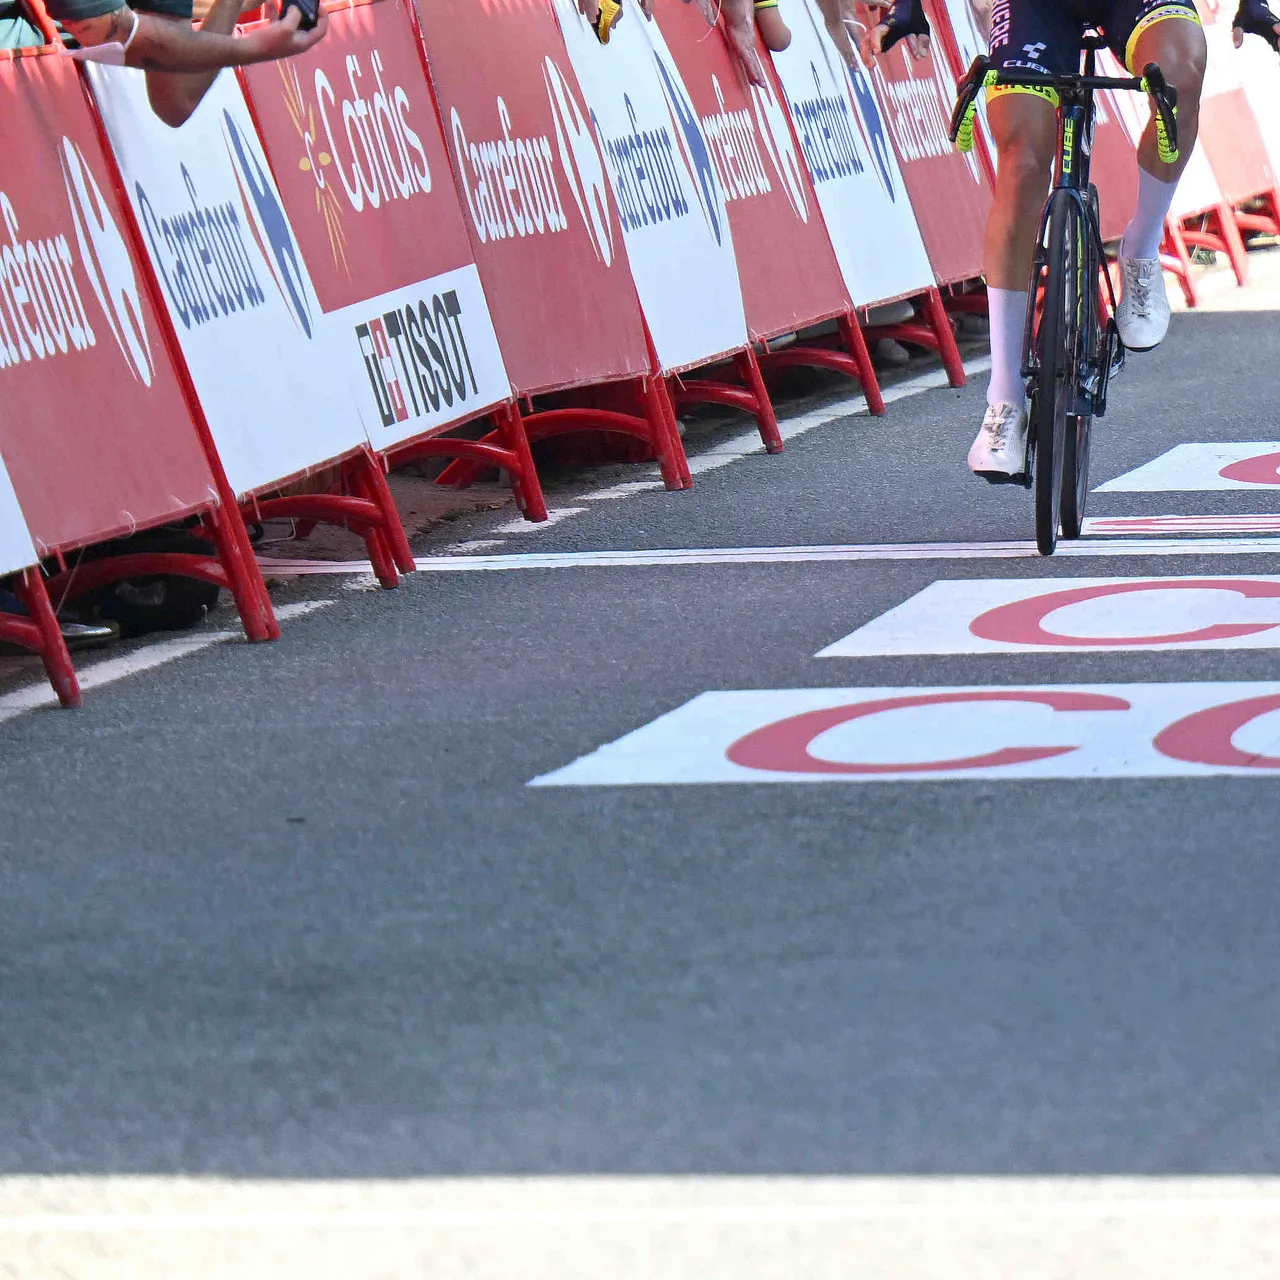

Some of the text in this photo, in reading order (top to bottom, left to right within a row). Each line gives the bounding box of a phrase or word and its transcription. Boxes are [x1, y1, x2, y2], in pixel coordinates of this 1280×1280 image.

[314, 49, 432, 213] Cofidis
[450, 95, 568, 245] Carrefour
[701, 72, 772, 203] rrefour
[1062, 117, 1074, 174] CUBE
[134, 160, 266, 330] Carrefour
[382, 289, 480, 418] TISSOT
